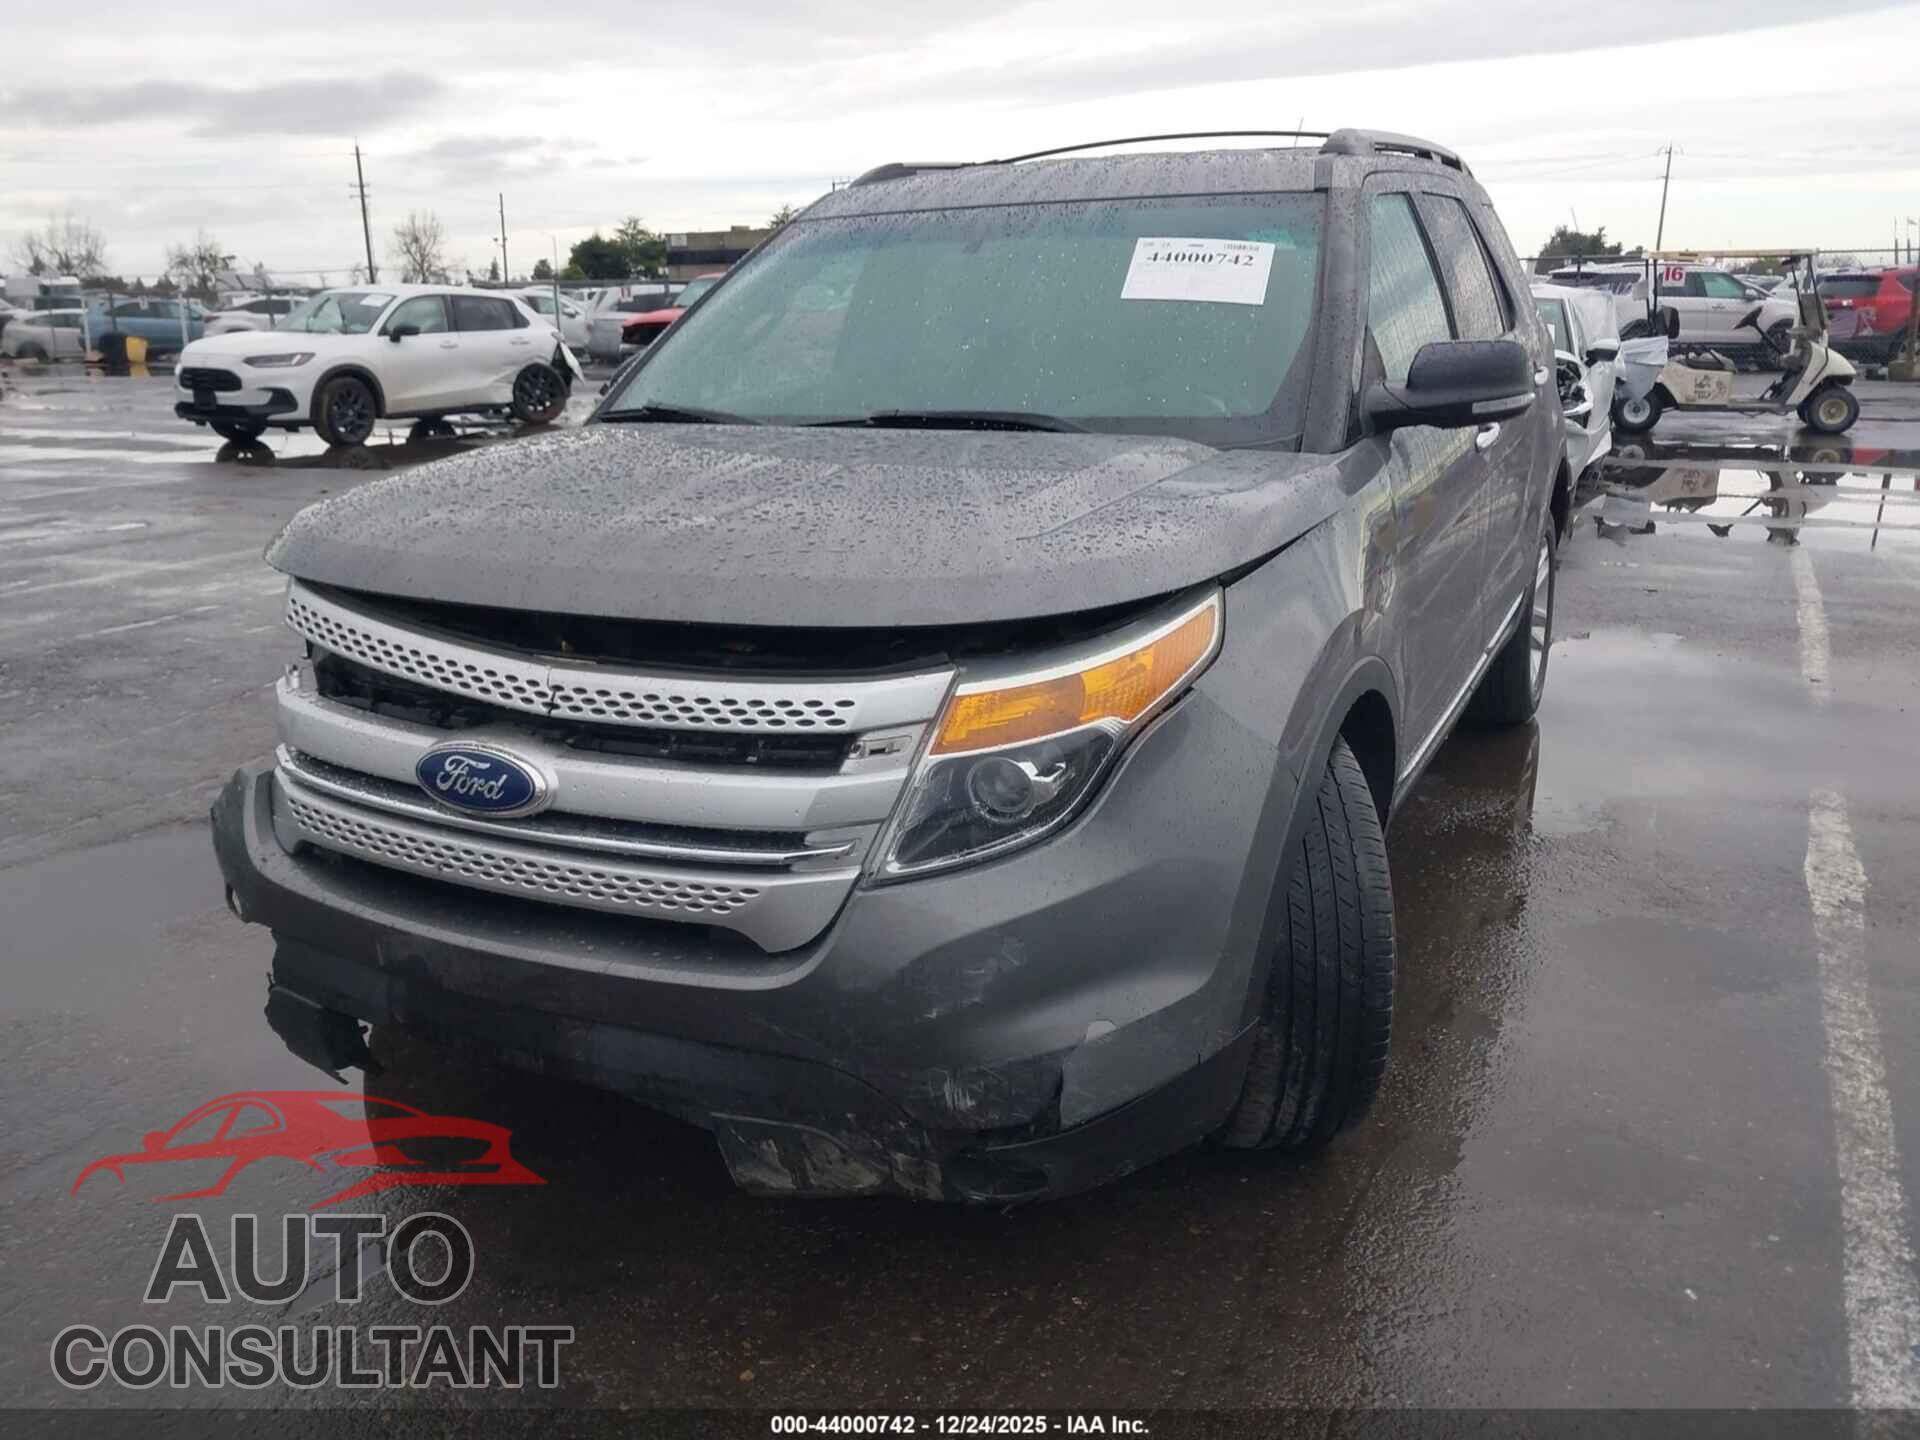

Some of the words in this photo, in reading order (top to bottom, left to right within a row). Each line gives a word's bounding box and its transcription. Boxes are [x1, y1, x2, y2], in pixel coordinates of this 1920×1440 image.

[1146, 251, 1254, 266] 44000742
[1664, 266, 1685, 281] 16
[436, 755, 507, 800] Ford
